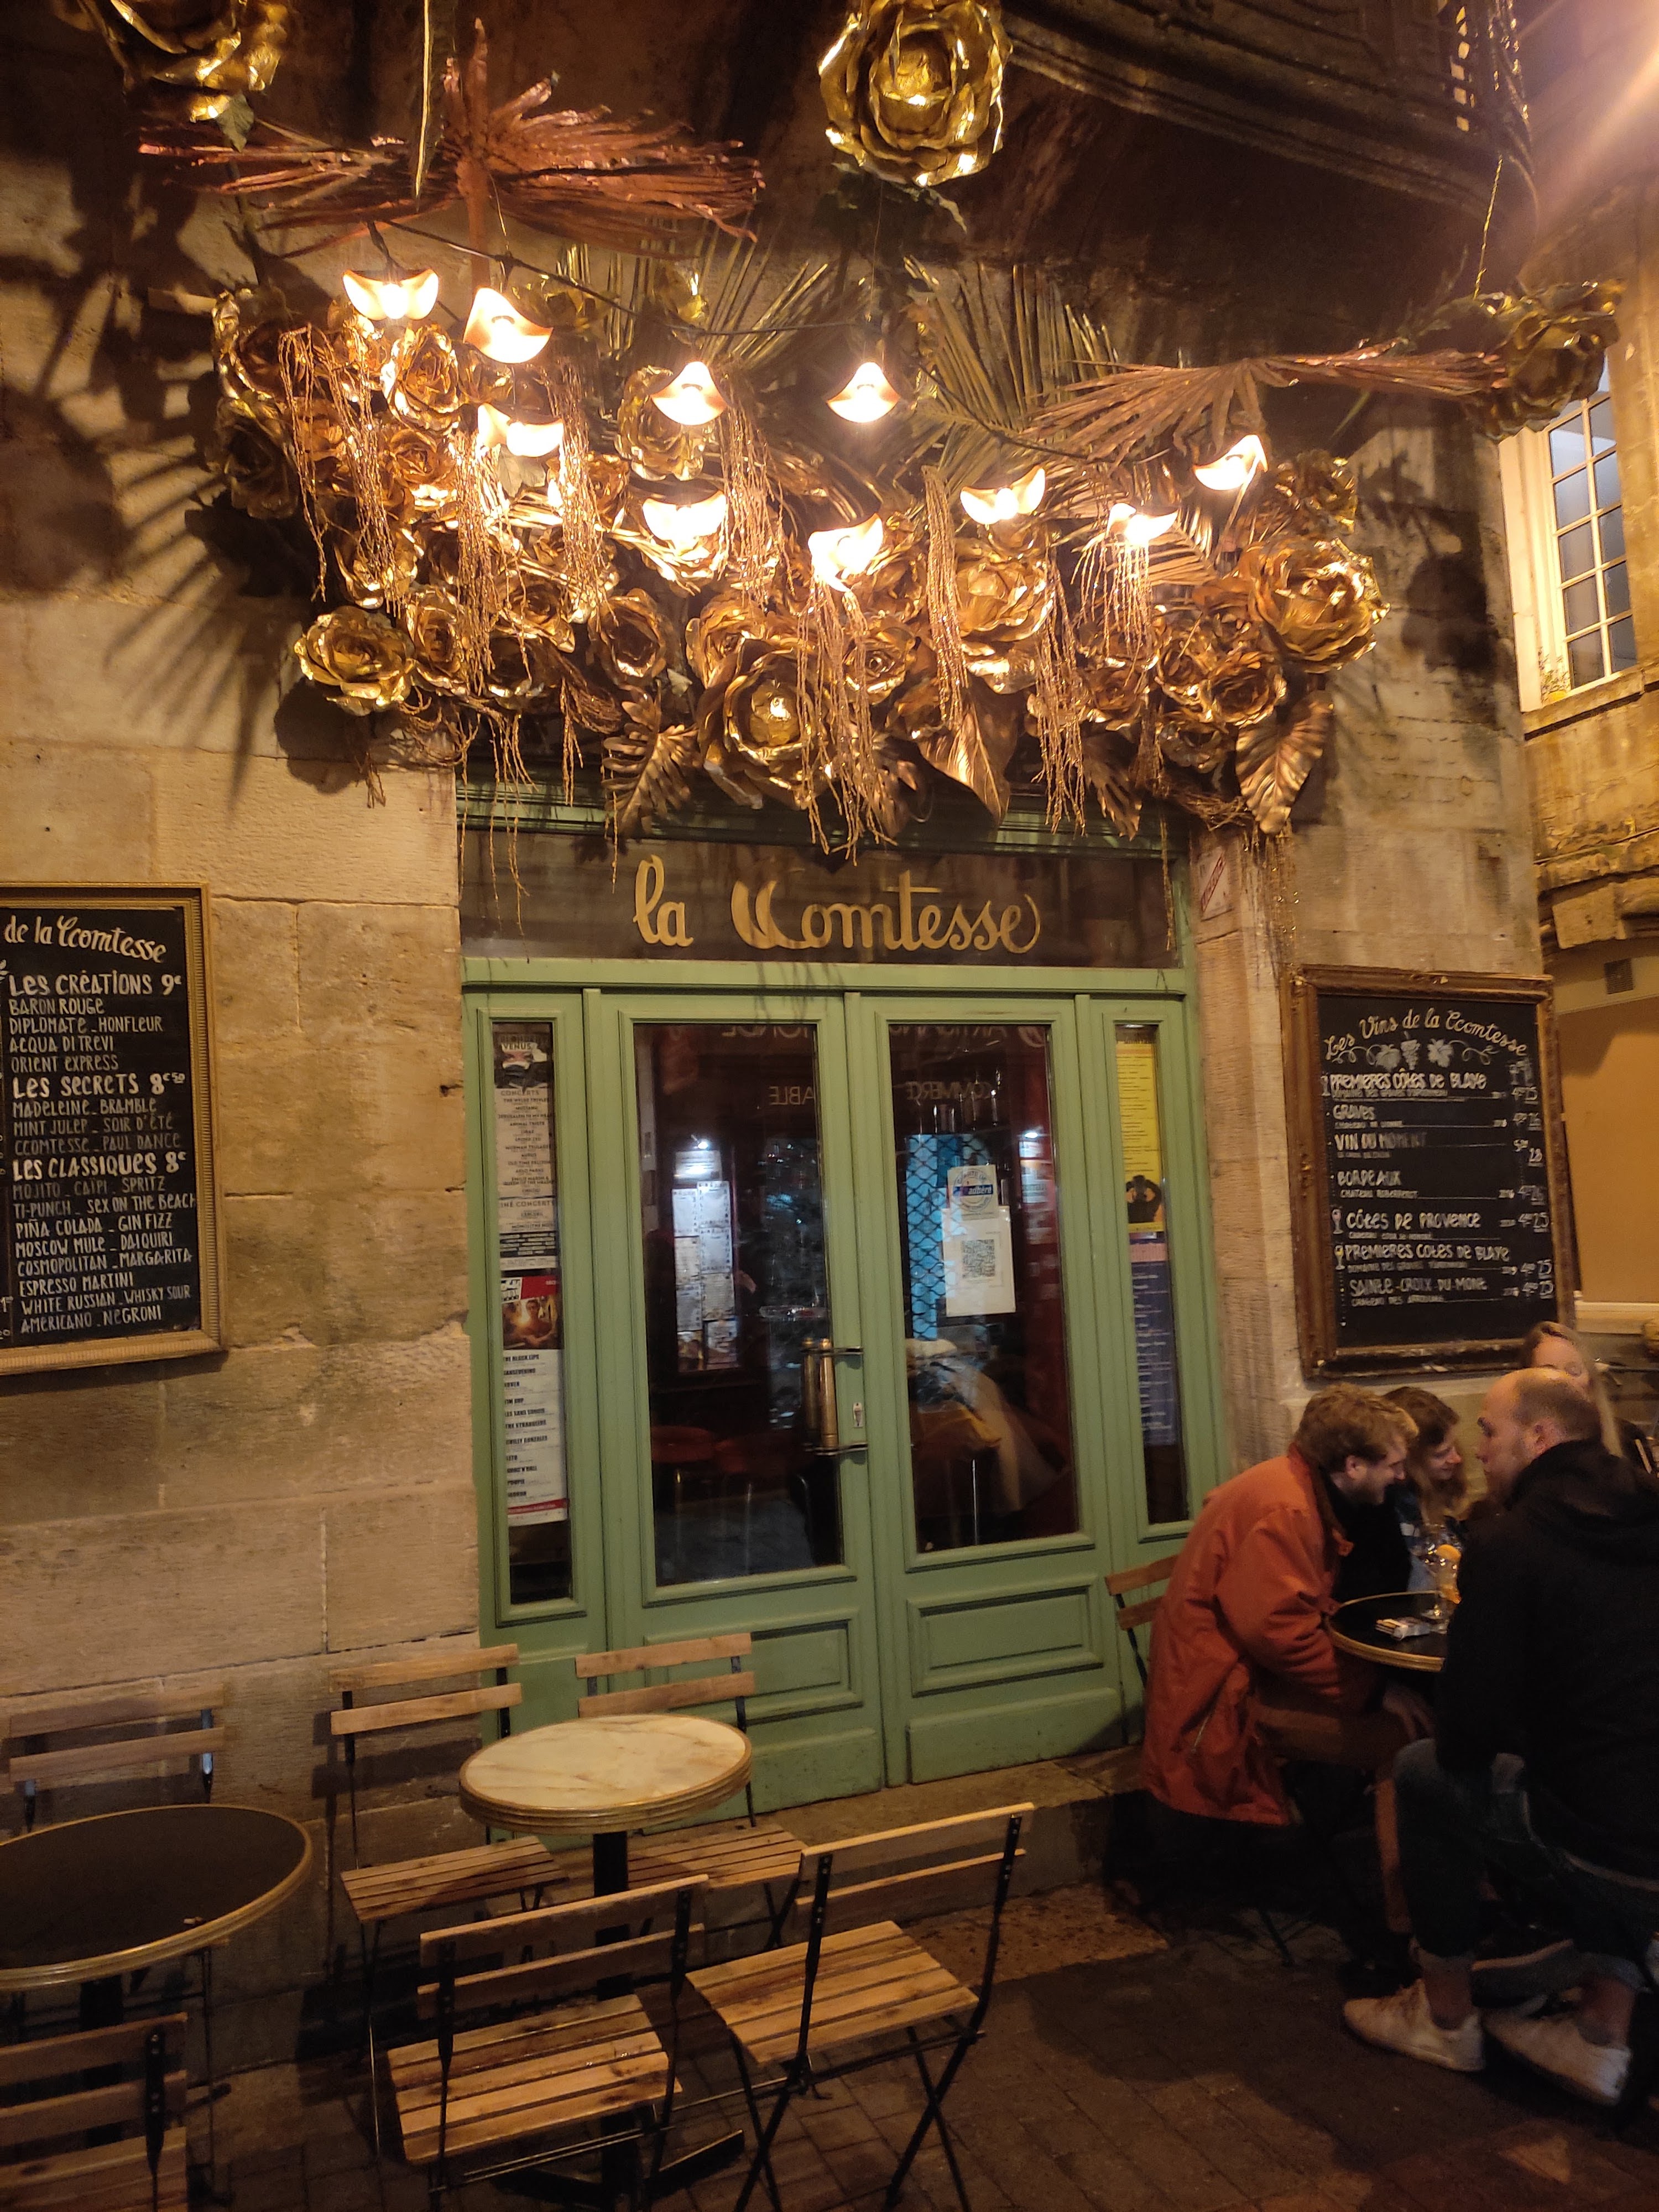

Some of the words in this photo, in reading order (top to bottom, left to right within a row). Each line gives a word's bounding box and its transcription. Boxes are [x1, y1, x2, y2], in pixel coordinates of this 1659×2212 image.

[632, 854, 694, 948] la
[4, 915, 29, 943] de
[35, 916, 54, 945] la
[8, 998, 55, 1016] BARON
[9, 1036, 58, 1053] ACQUA
[62, 1035, 75, 1051] DI
[1323, 1034, 1355, 1060] Les
[1359, 1015, 1399, 1039] Vins
[1402, 1009, 1420, 1029] de
[1425, 1007, 1440, 1029] la
[13, 1121, 45, 1137] MINT
[103, 1117, 132, 1132] SOIR
[103, 1136, 132, 1152] PAUL
[1334, 1133, 1358, 1151] VIN
[1361, 1133, 1376, 1149] DU
[13, 1182, 61, 1200] MOJITO
[122, 1176, 165, 1192] SPRITZ
[112, 1197, 128, 1212] ON
[56, 1217, 103, 1236] COLADA
[118, 1214, 142, 1230] GIN
[145, 1212, 173, 1229] FIZZ
[15, 1239, 69, 1259] MOSCOW
[121, 1231, 174, 1250] DAIQUIRI
[17, 1255, 107, 1277] COSMOPOLITAN
[119, 1248, 192, 1267] MARGARITA
[82, 1271, 134, 1291] MARTINI
[21, 1297, 64, 1316] WHITE
[67, 1292, 116, 1311] RUSSIAN
[124, 1287, 164, 1305] WHISKY
[167, 1285, 191, 1300] SOUR
